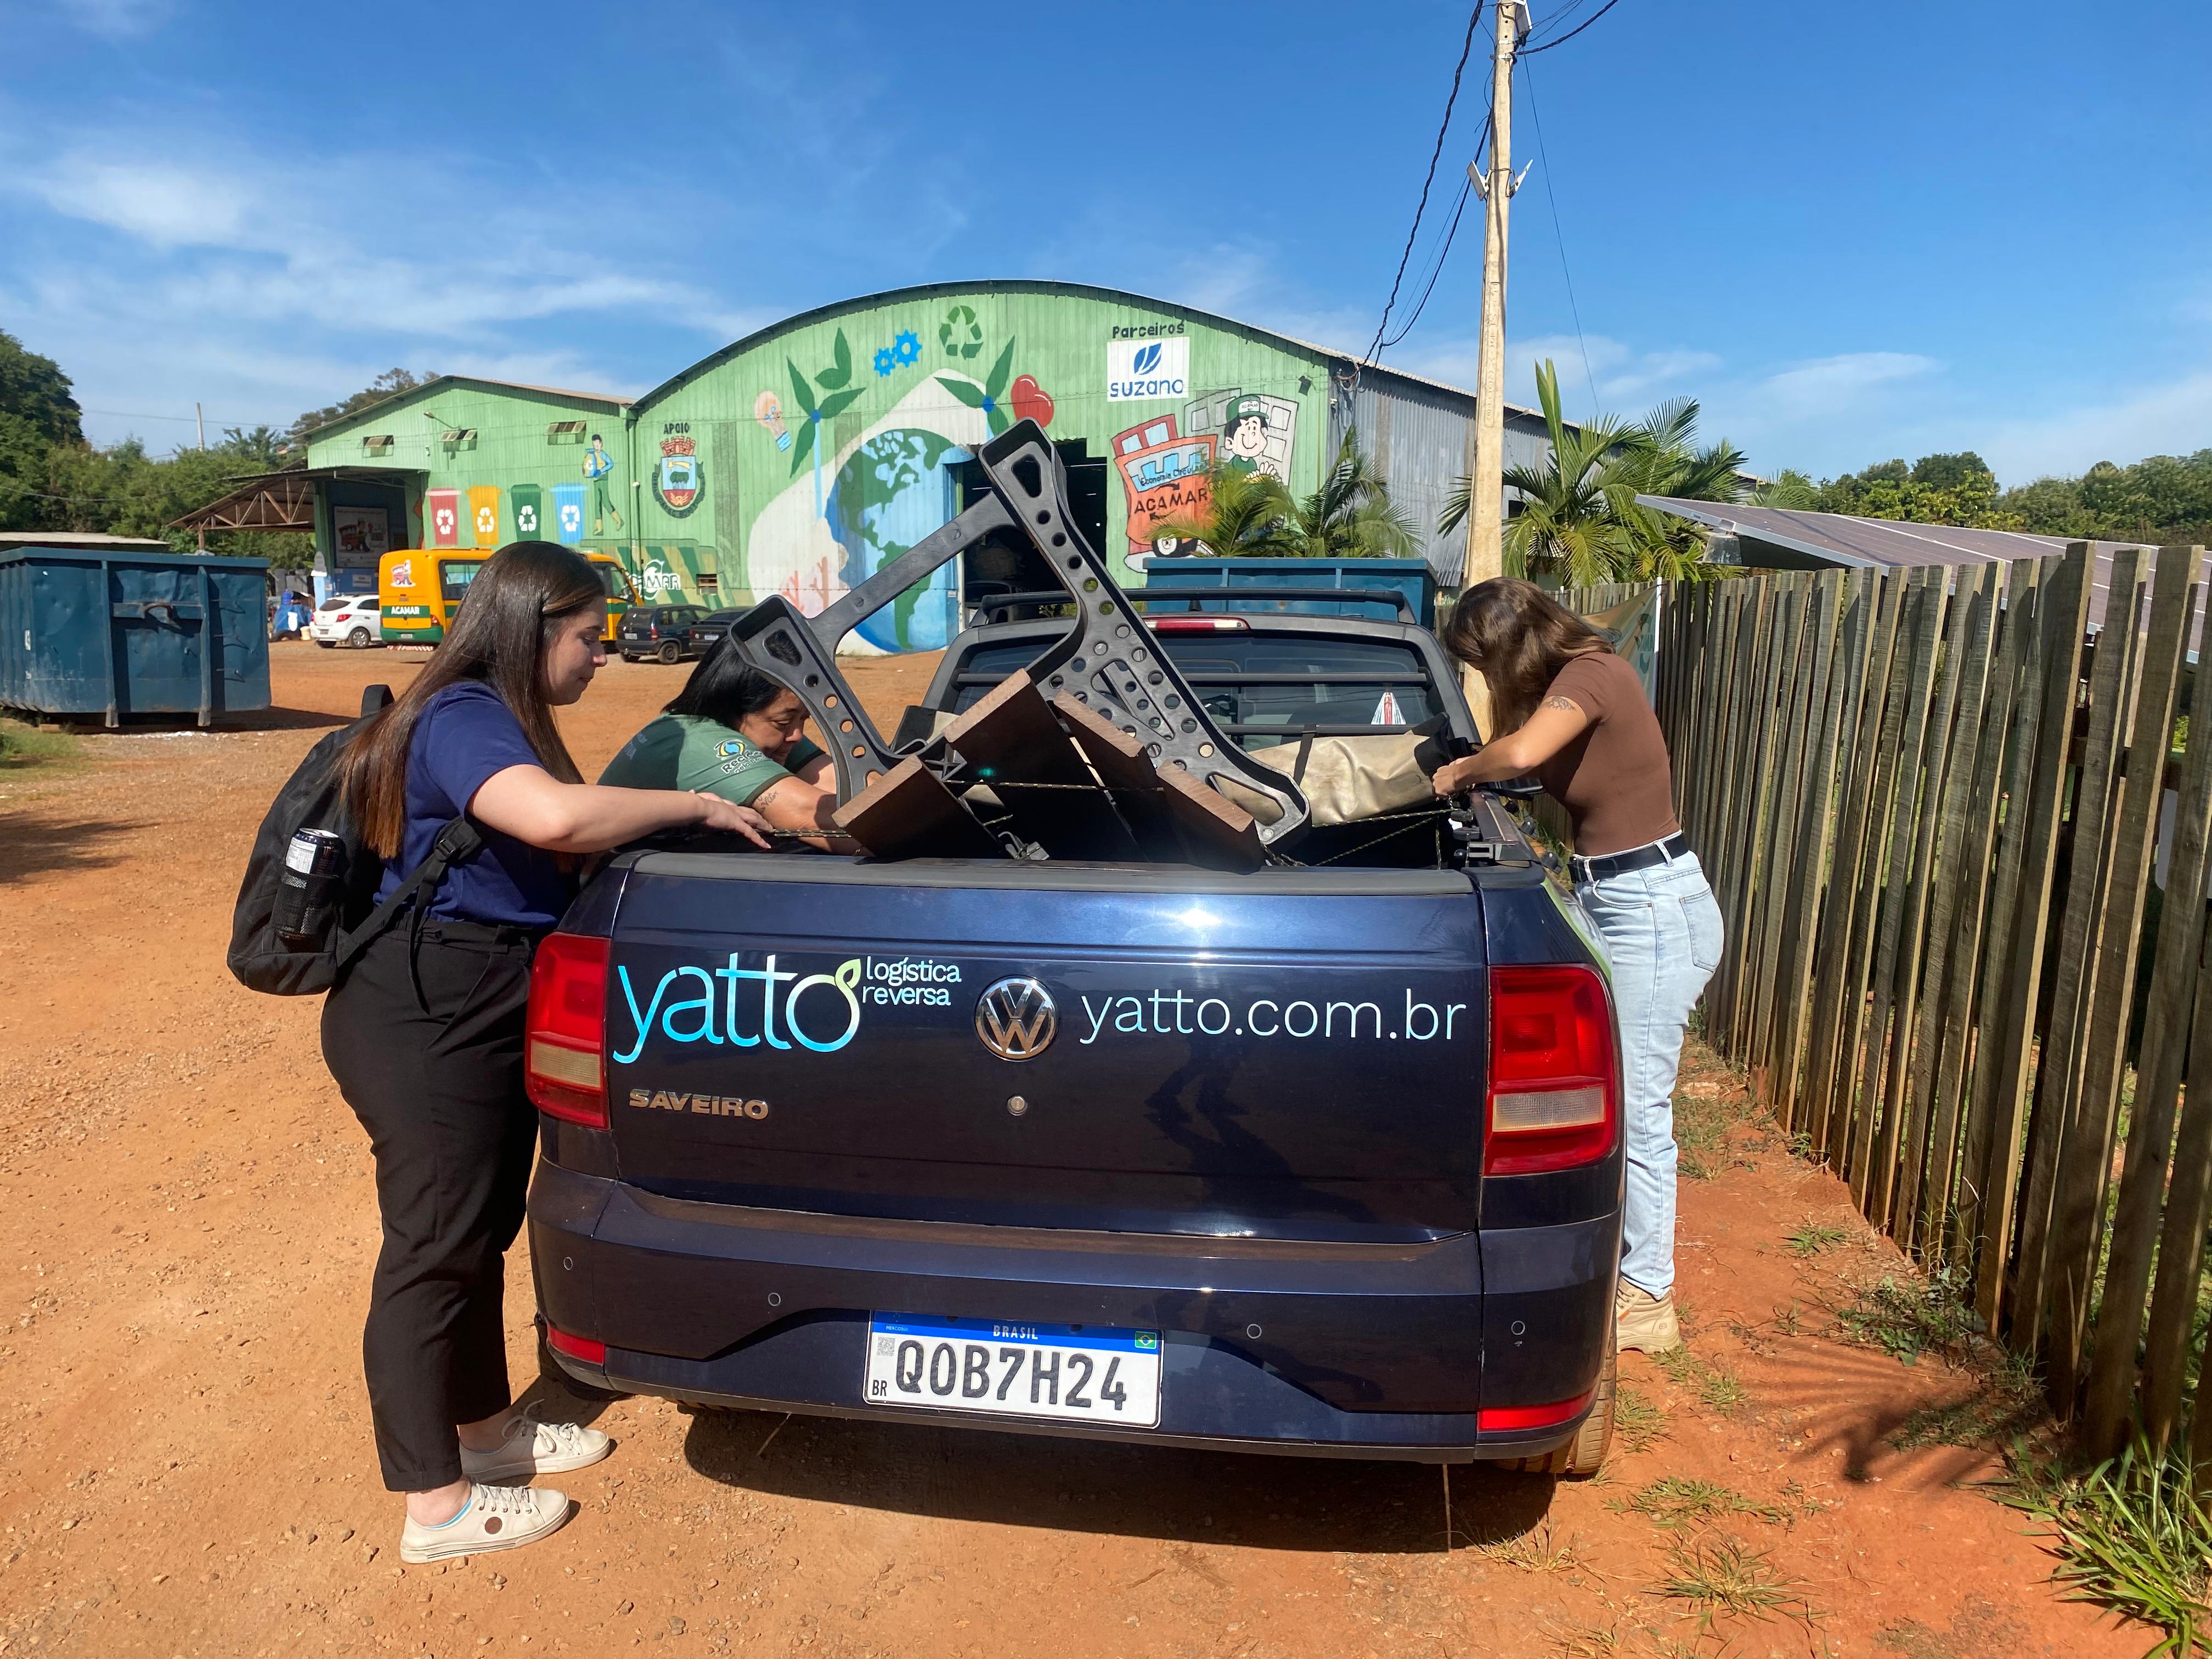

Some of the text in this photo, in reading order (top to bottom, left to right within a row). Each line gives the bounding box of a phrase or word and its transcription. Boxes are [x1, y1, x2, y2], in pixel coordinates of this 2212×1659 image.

[1112, 322, 1185, 339] Parceiros
[1109, 379, 1184, 398] suzano
[663, 422, 690, 435] APOIO
[1141, 473, 1171, 487] Economia
[1134, 488, 1207, 514] ACAMAR
[391, 606, 420, 615] ACAMAR
[866, 956, 962, 986] logística
[862, 985, 951, 1006] reversa
[613, 952, 861, 1064] yatto
[1079, 988, 1466, 1044] yatto.com.br
[629, 1089, 769, 1120] SAVEIRO
[993, 1325, 1039, 1340] BRASIL
[872, 1379, 888, 1397] BR
